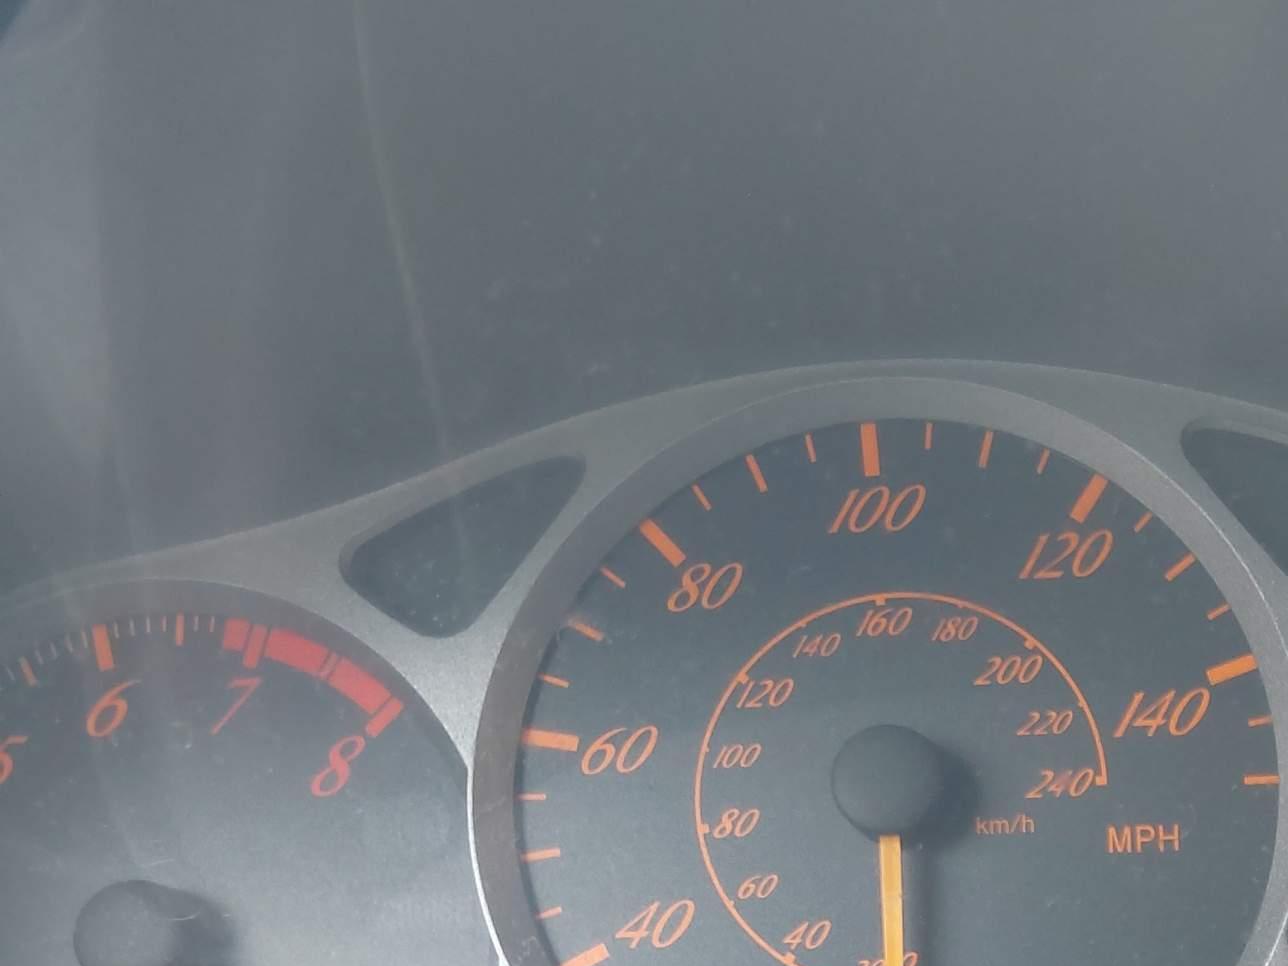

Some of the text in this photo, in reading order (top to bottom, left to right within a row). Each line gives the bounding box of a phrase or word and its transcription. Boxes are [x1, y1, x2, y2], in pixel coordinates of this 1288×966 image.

[831, 484, 926, 534] 100
[1019, 529, 1113, 580] 120
[667, 562, 743, 613] 80
[858, 606, 913, 638] 160
[932, 616, 978, 642] 180
[792, 632, 841, 658] 140
[974, 656, 1043, 686] 200
[86, 680, 141, 737] 6
[212, 677, 261, 734] 7
[736, 678, 794, 709] 120
[1017, 709, 1074, 737] 220
[1113, 688, 1211, 737] 140
[581, 726, 658, 774] 60
[712, 742, 762, 769] 100
[311, 736, 365, 797] 8
[1025, 767, 1091, 799] 240
[712, 808, 760, 837] 80
[975, 814, 1035, 835] km/h
[1106, 823, 1181, 853] MPH
[736, 874, 778, 900] 60
[615, 900, 696, 949] 40
[784, 920, 832, 950] 40
